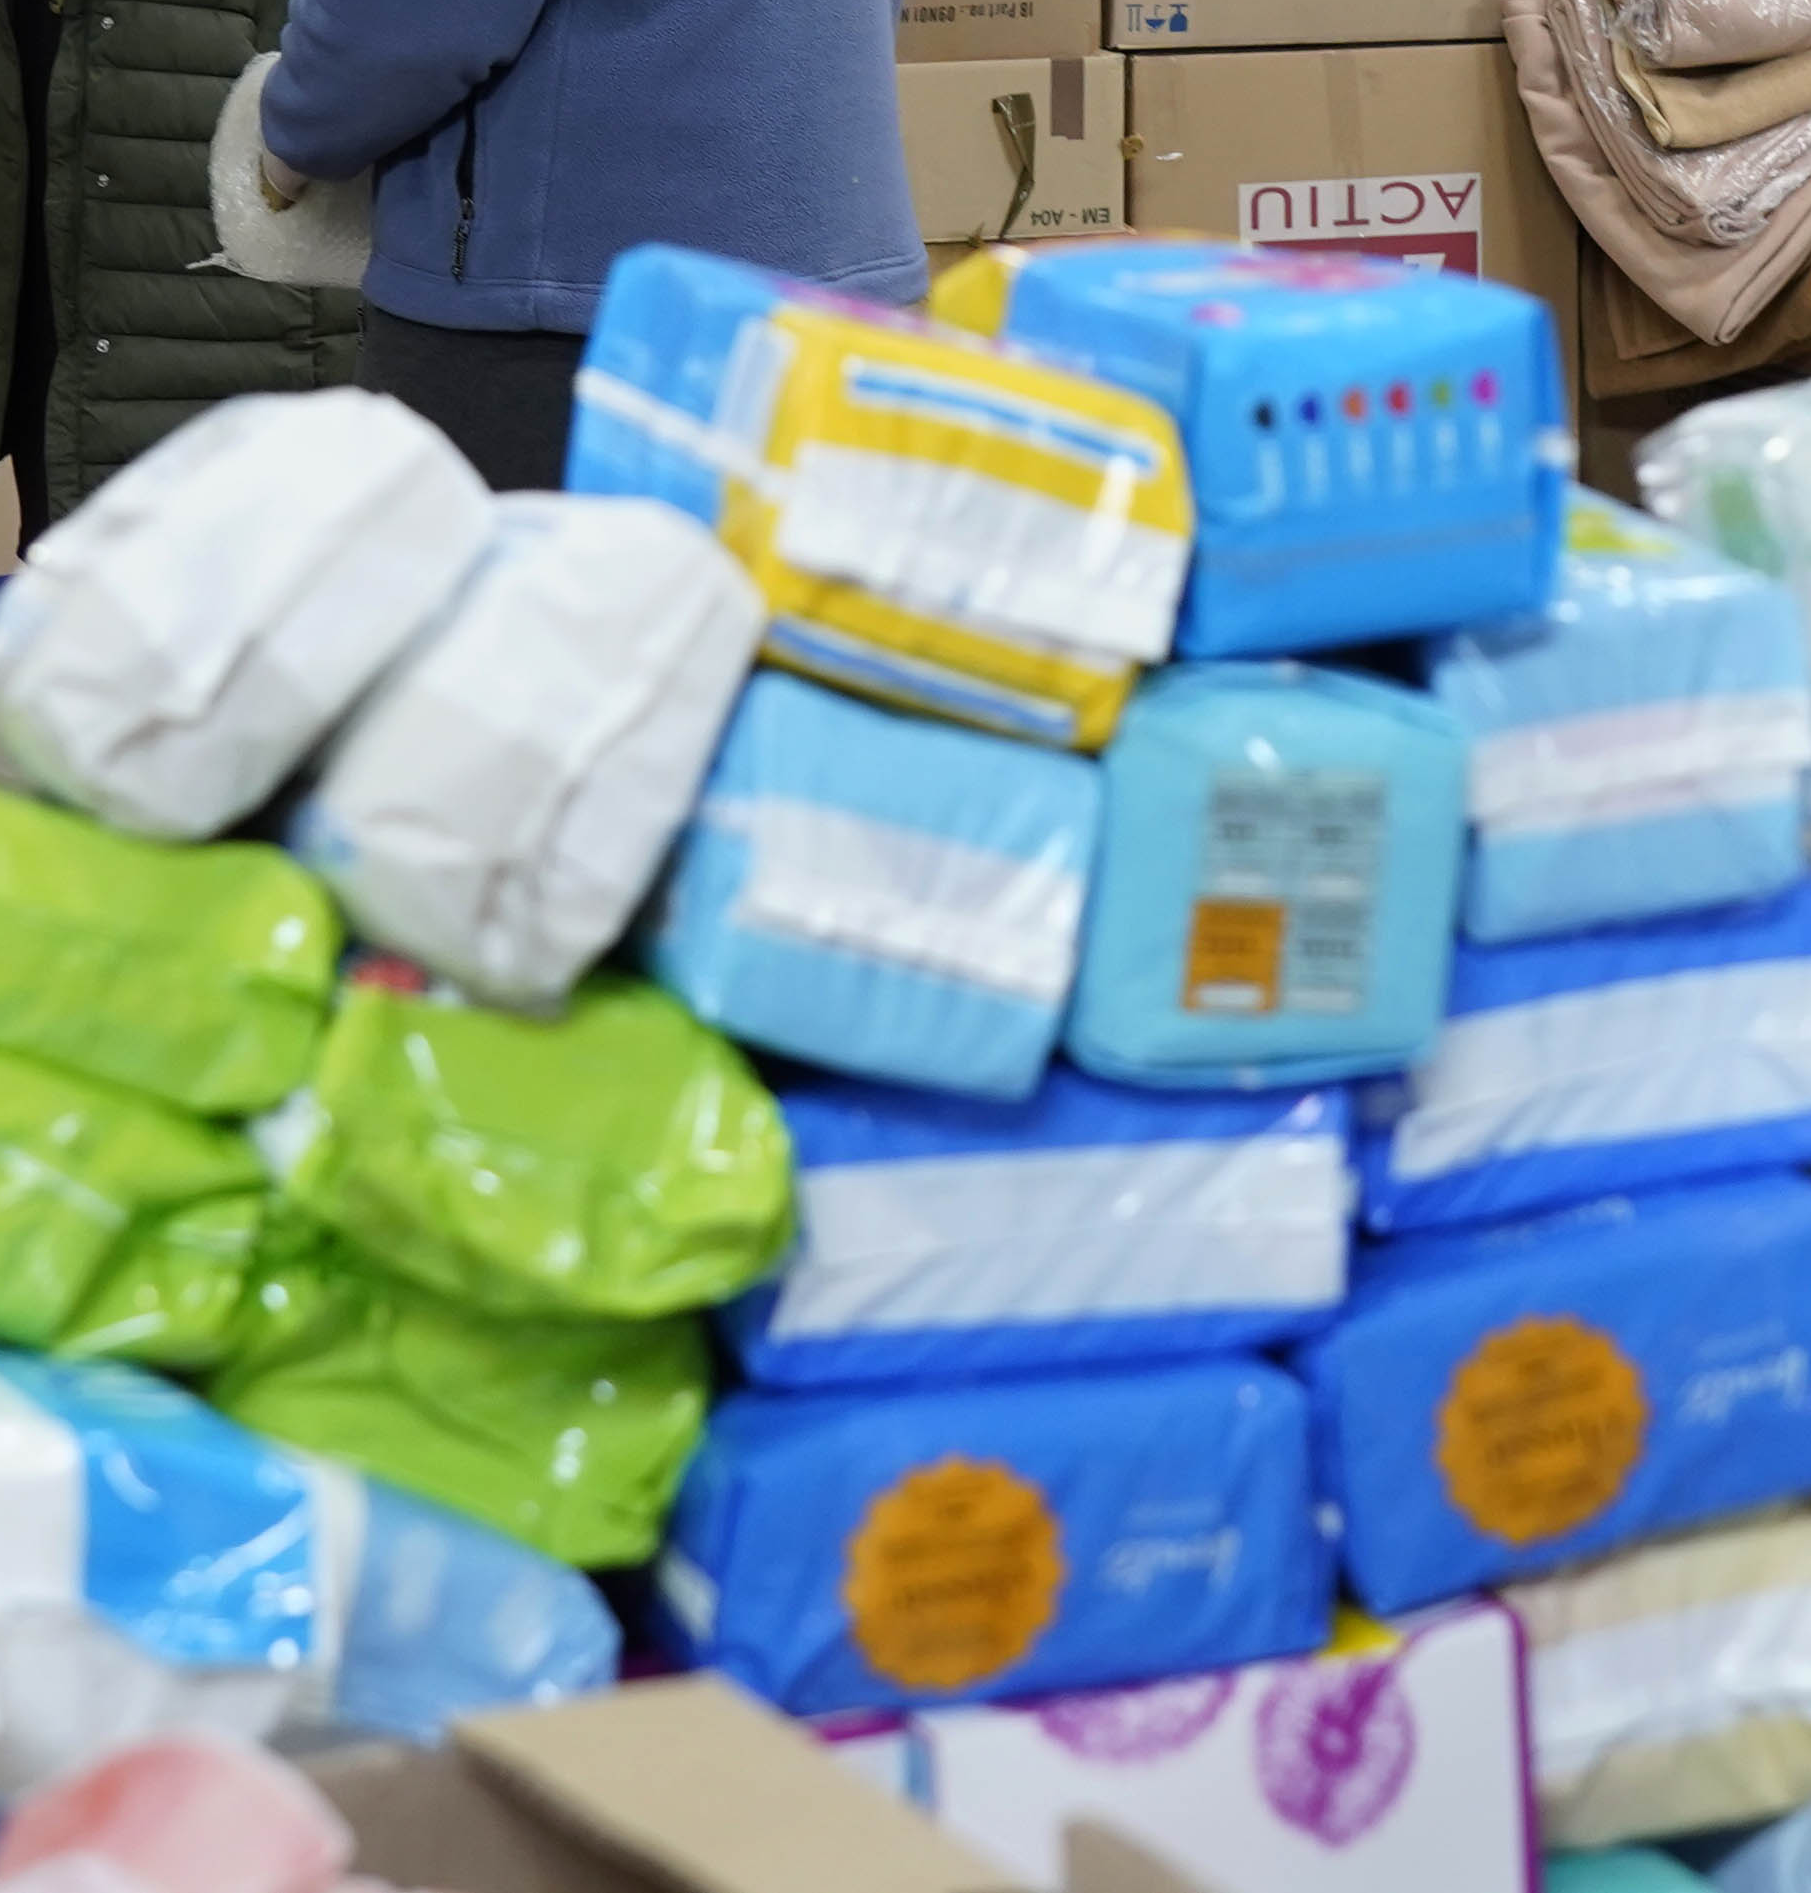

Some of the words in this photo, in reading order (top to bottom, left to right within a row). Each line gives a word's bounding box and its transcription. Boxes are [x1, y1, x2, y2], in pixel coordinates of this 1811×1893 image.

[988, 2, 1016, 20] Part
[1250, 178, 1477, 231] ACTIU
[1030, 209, 1064, 226] A04
[1081, 207, 1110, 224] EM
